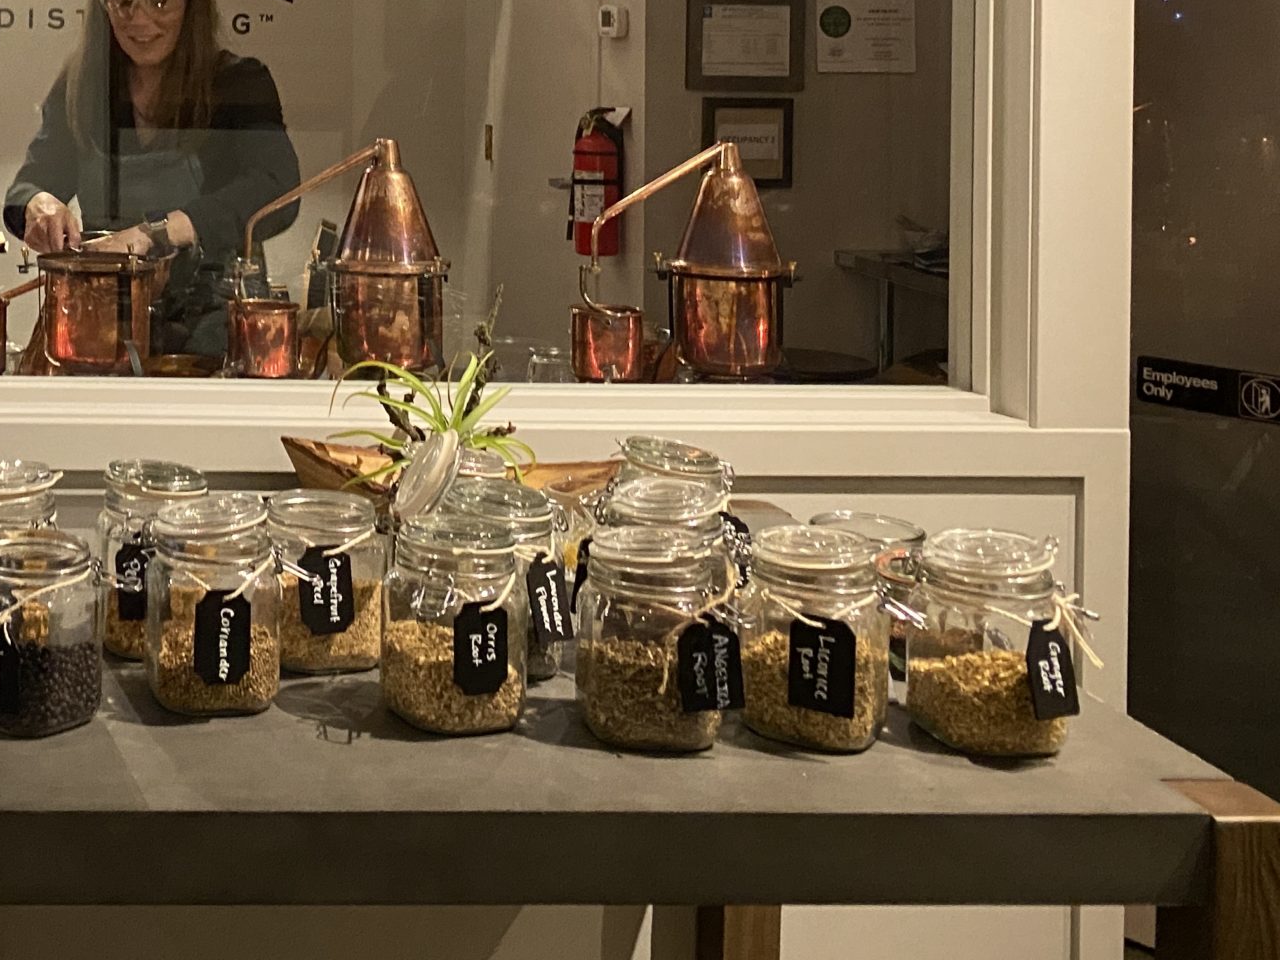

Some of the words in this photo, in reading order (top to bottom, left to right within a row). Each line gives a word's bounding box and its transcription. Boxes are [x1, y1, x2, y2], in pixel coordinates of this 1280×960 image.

[1143, 367, 1218, 391] Employees
[1143, 382, 1173, 401] Only
[326, 558, 343, 623] Grapefruit
[546, 569, 564, 636] Lavender
[218, 608, 235, 682] Coriander
[469, 633, 483, 668] Root
[486, 622, 498, 661] Orris
[796, 647, 814, 680] Root
[1038, 660, 1054, 694] Root
[1049, 641, 1066, 698] Ginger
